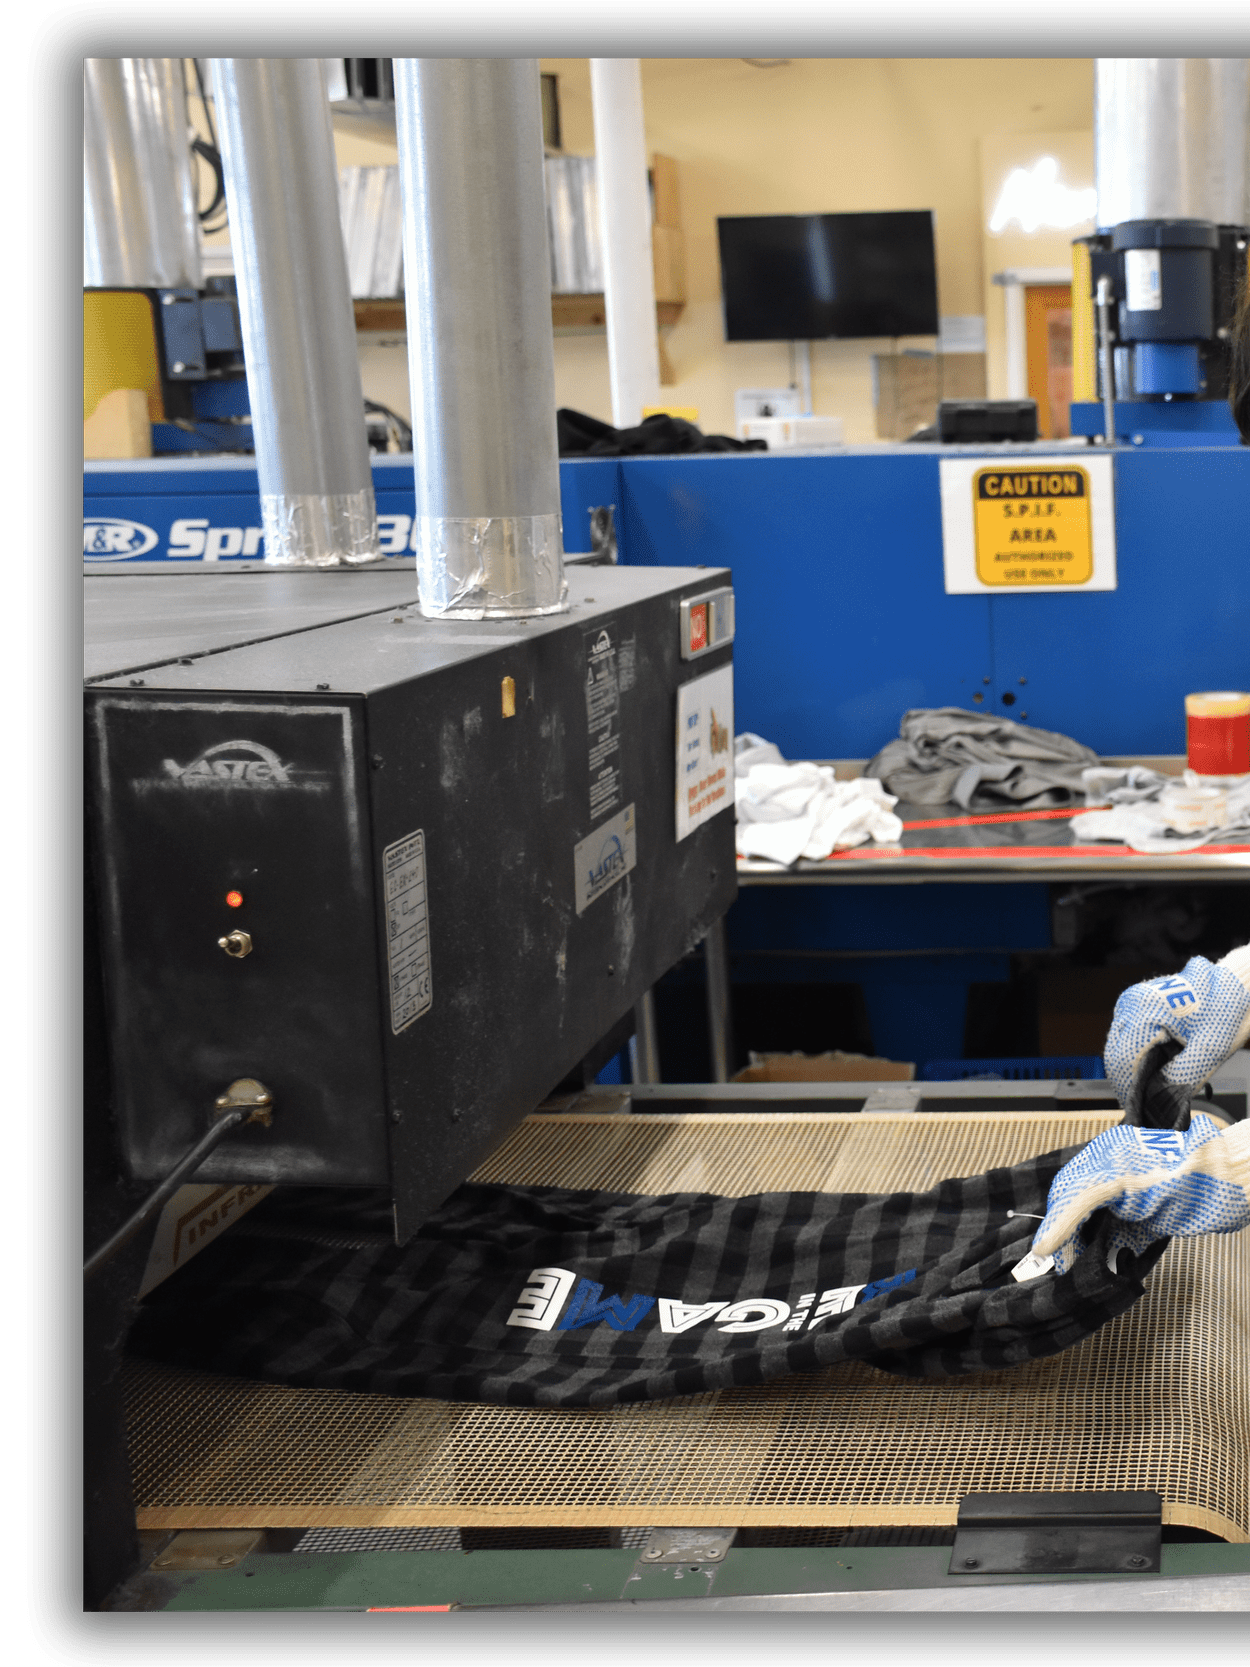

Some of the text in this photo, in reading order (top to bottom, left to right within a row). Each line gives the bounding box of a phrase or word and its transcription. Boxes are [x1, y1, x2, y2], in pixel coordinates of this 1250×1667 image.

[985, 474, 1078, 496] CAUTION
[1003, 502, 1061, 518] S.P.I.F.
[1008, 528, 1057, 543] AREA
[993, 551, 1074, 562] AUTHORIZED
[1003, 568, 1065, 580] USE ONLY
[161, 757, 296, 783] VASTEX
[506, 1267, 790, 1333] GAME
[796, 1293, 817, 1309] IN
[781, 1308, 809, 1332] THE
